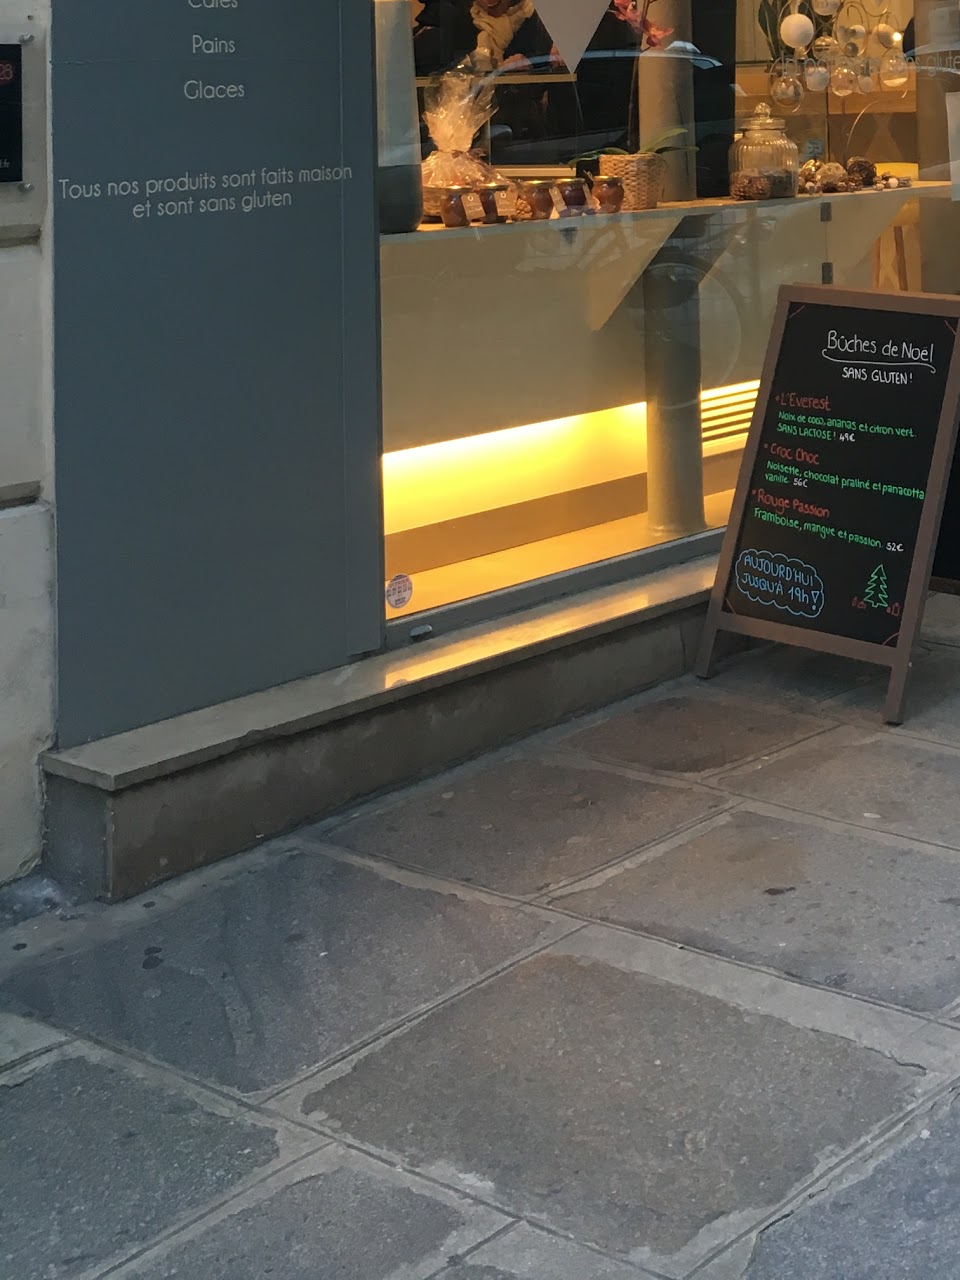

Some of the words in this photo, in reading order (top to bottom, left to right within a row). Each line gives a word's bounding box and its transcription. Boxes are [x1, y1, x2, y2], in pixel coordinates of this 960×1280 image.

[192, 34, 236, 54] Pains
[184, 80, 245, 100] Glaces
[58, 178, 101, 199] Tous
[107, 178, 139, 197] nos
[146, 172, 217, 197] produits
[222, 169, 257, 189] sont
[261, 166, 294, 186] faits
[298, 165, 353, 183] maison
[132, 200, 152, 218] et
[157, 196, 194, 216] sont
[199, 194, 236, 213] sans
[241, 191, 292, 212] gluten
[827, 330, 877, 354] Bûches
[881, 339, 899, 357] de
[901, 341, 934, 363] Noël
[842, 367, 868, 381] SANS
[777, 422, 798, 436] SANS
[838, 432, 856, 443] 49€
[778, 411, 796, 422] Noix
[796, 414, 806, 423] de
[827, 418, 856, 431] ananas
[858, 422, 869, 432] et
[869, 423, 894, 436] citron
[770, 443, 793, 460] Croc
[795, 448, 820, 465] Choc
[793, 477, 808, 488] 56€
[803, 470, 840, 484] chocolat
[841, 476, 871, 490] praliné
[872, 483, 881, 491] et
[882, 484, 925, 500] panacotta
[757, 488, 790, 515] Rouge
[792, 498, 830, 518] Passion
[803, 521, 835, 539] mangue
[837, 529, 847, 540] et
[885, 542, 904, 552] 52€
[744, 554, 814, 587] AUJOURD'HUI
